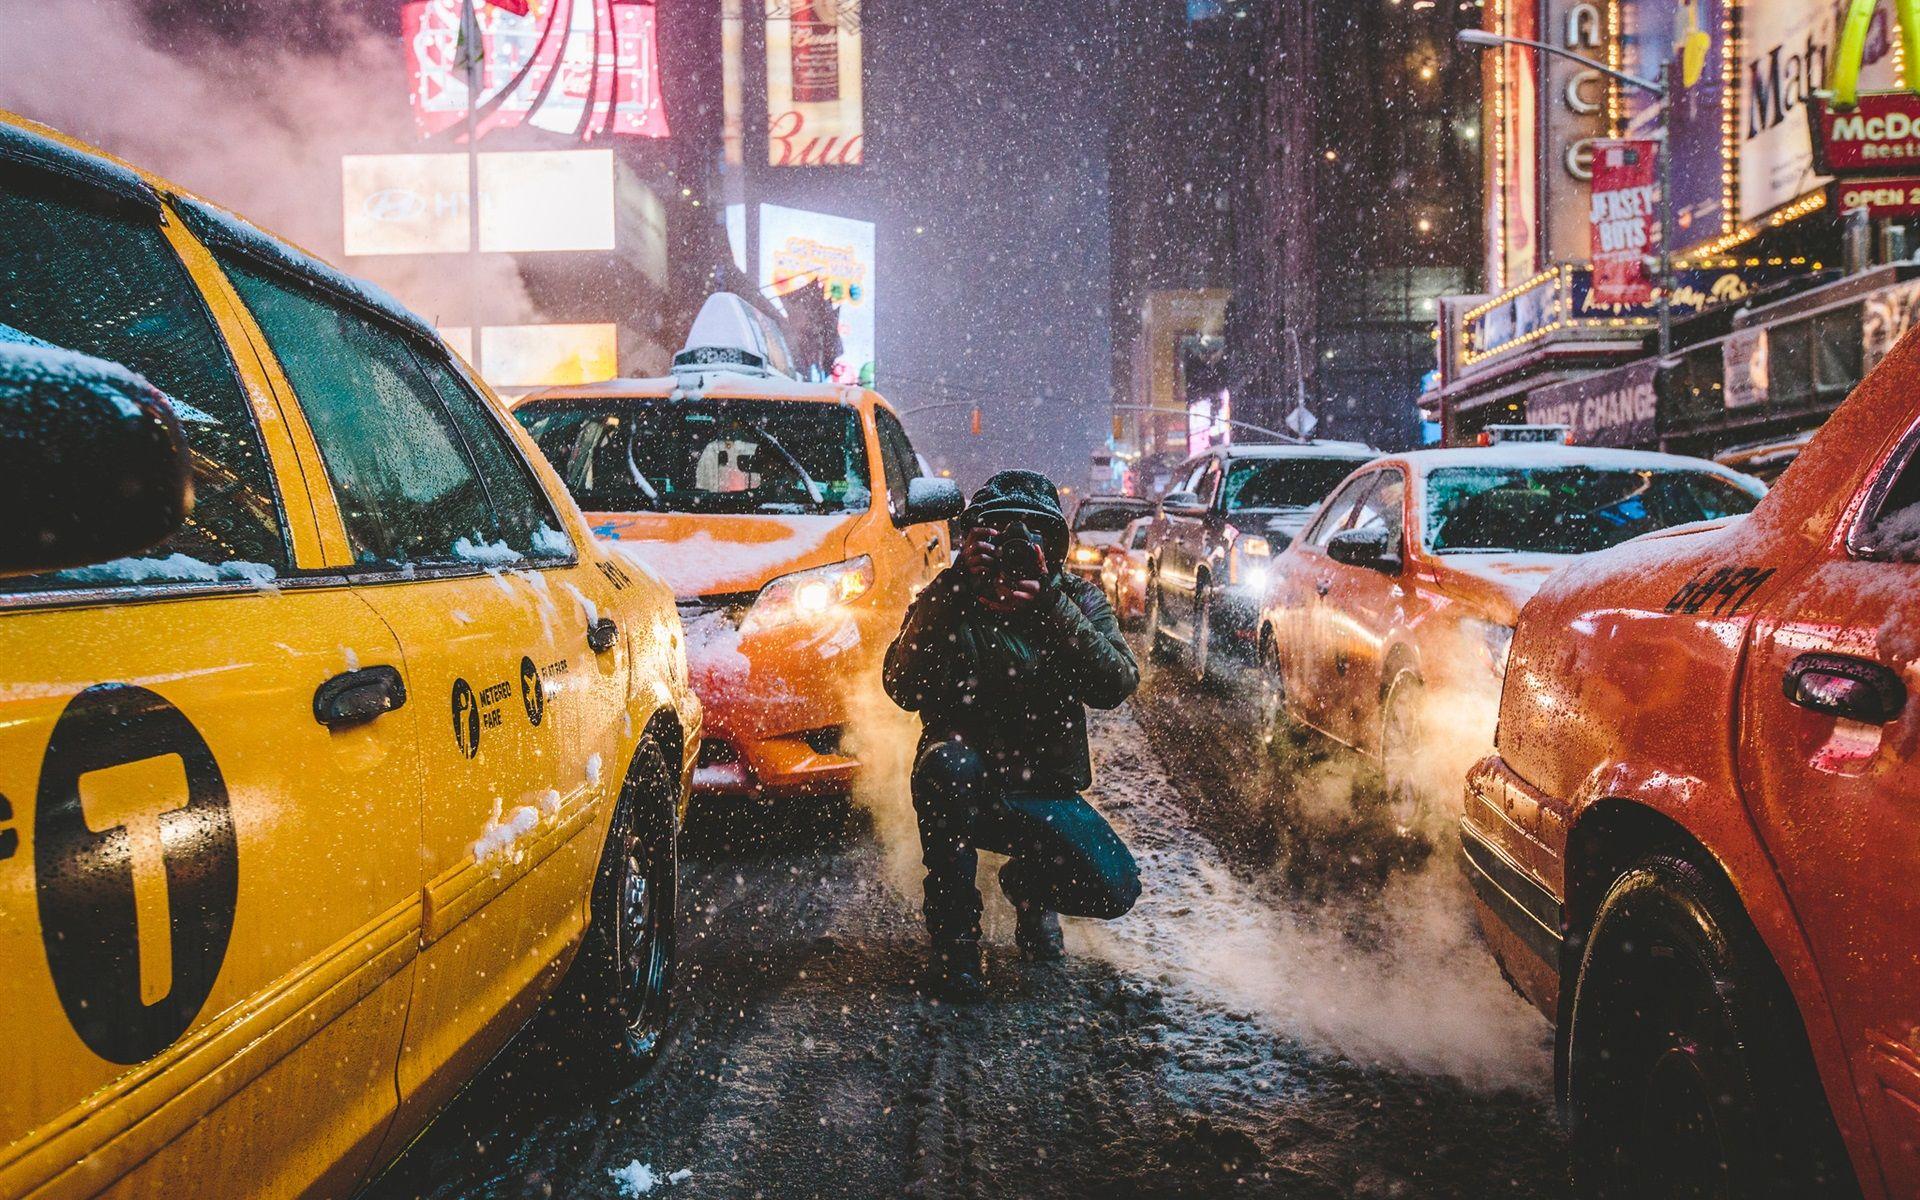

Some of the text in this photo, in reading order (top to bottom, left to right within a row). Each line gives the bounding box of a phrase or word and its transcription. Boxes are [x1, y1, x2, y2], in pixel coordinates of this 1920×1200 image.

[1590, 186, 1653, 223] JERSEY
[1843, 187, 1905, 207] OPEN
[1599, 218, 1647, 252] BOYS
[479, 680, 512, 708] METERED
[483, 708, 503, 730] FARE
